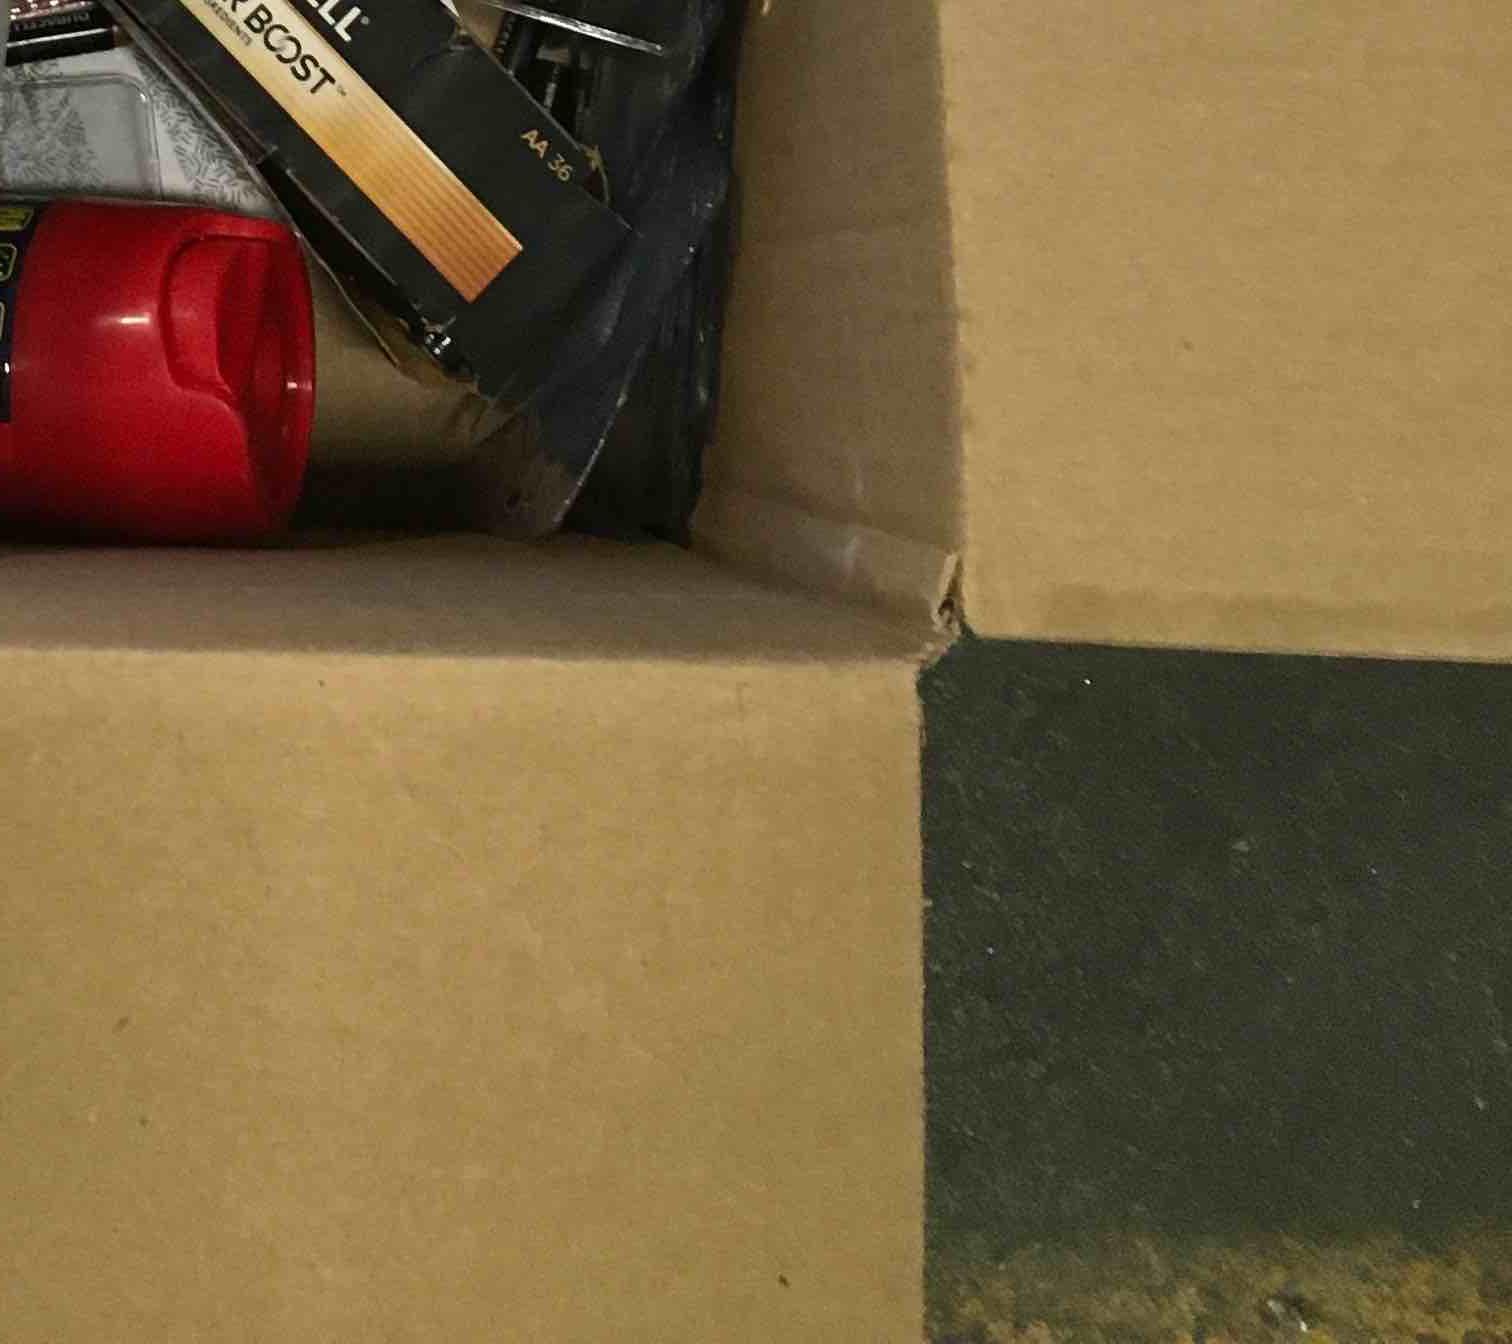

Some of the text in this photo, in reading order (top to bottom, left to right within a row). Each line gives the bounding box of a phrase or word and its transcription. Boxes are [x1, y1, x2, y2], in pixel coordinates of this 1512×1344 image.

[244, 3, 336, 95] BOOST
[520, 128, 574, 182] AA 36
